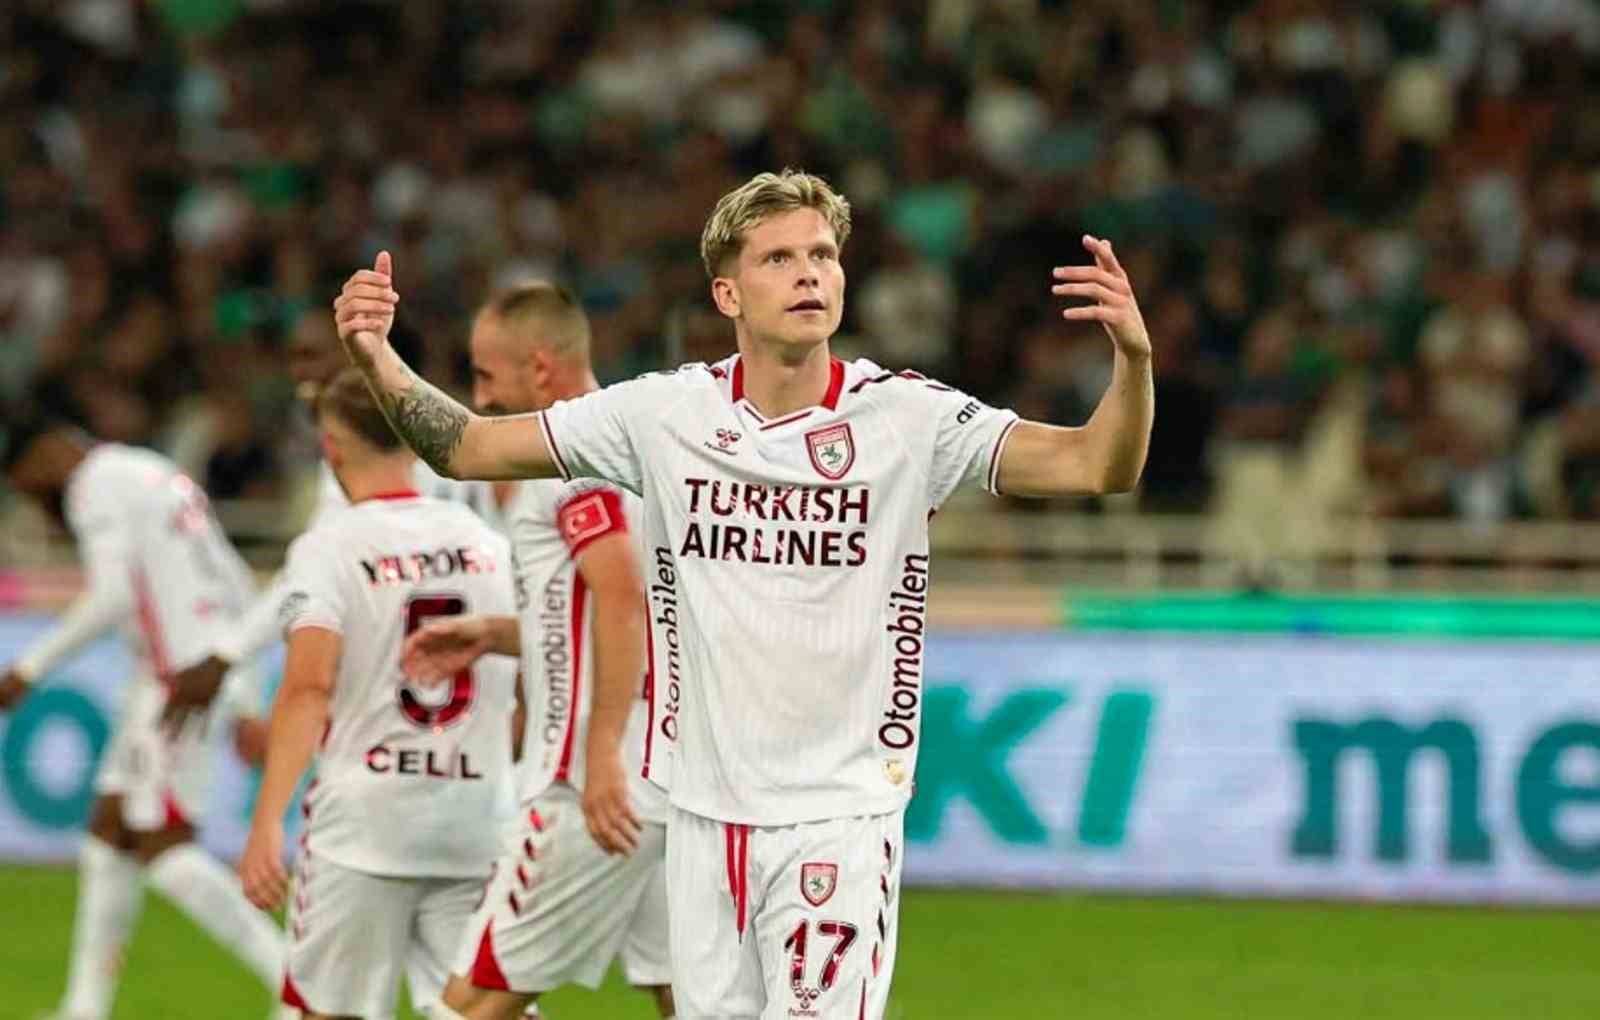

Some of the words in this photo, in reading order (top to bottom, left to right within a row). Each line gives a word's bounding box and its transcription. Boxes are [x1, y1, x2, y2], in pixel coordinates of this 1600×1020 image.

[684, 478, 869, 524] TURKISH
[680, 522, 867, 567] AIRLINES
[653, 545, 681, 742] Otomobilen
[877, 553, 929, 750] Otomobilen
[783, 918, 859, 992] 17
